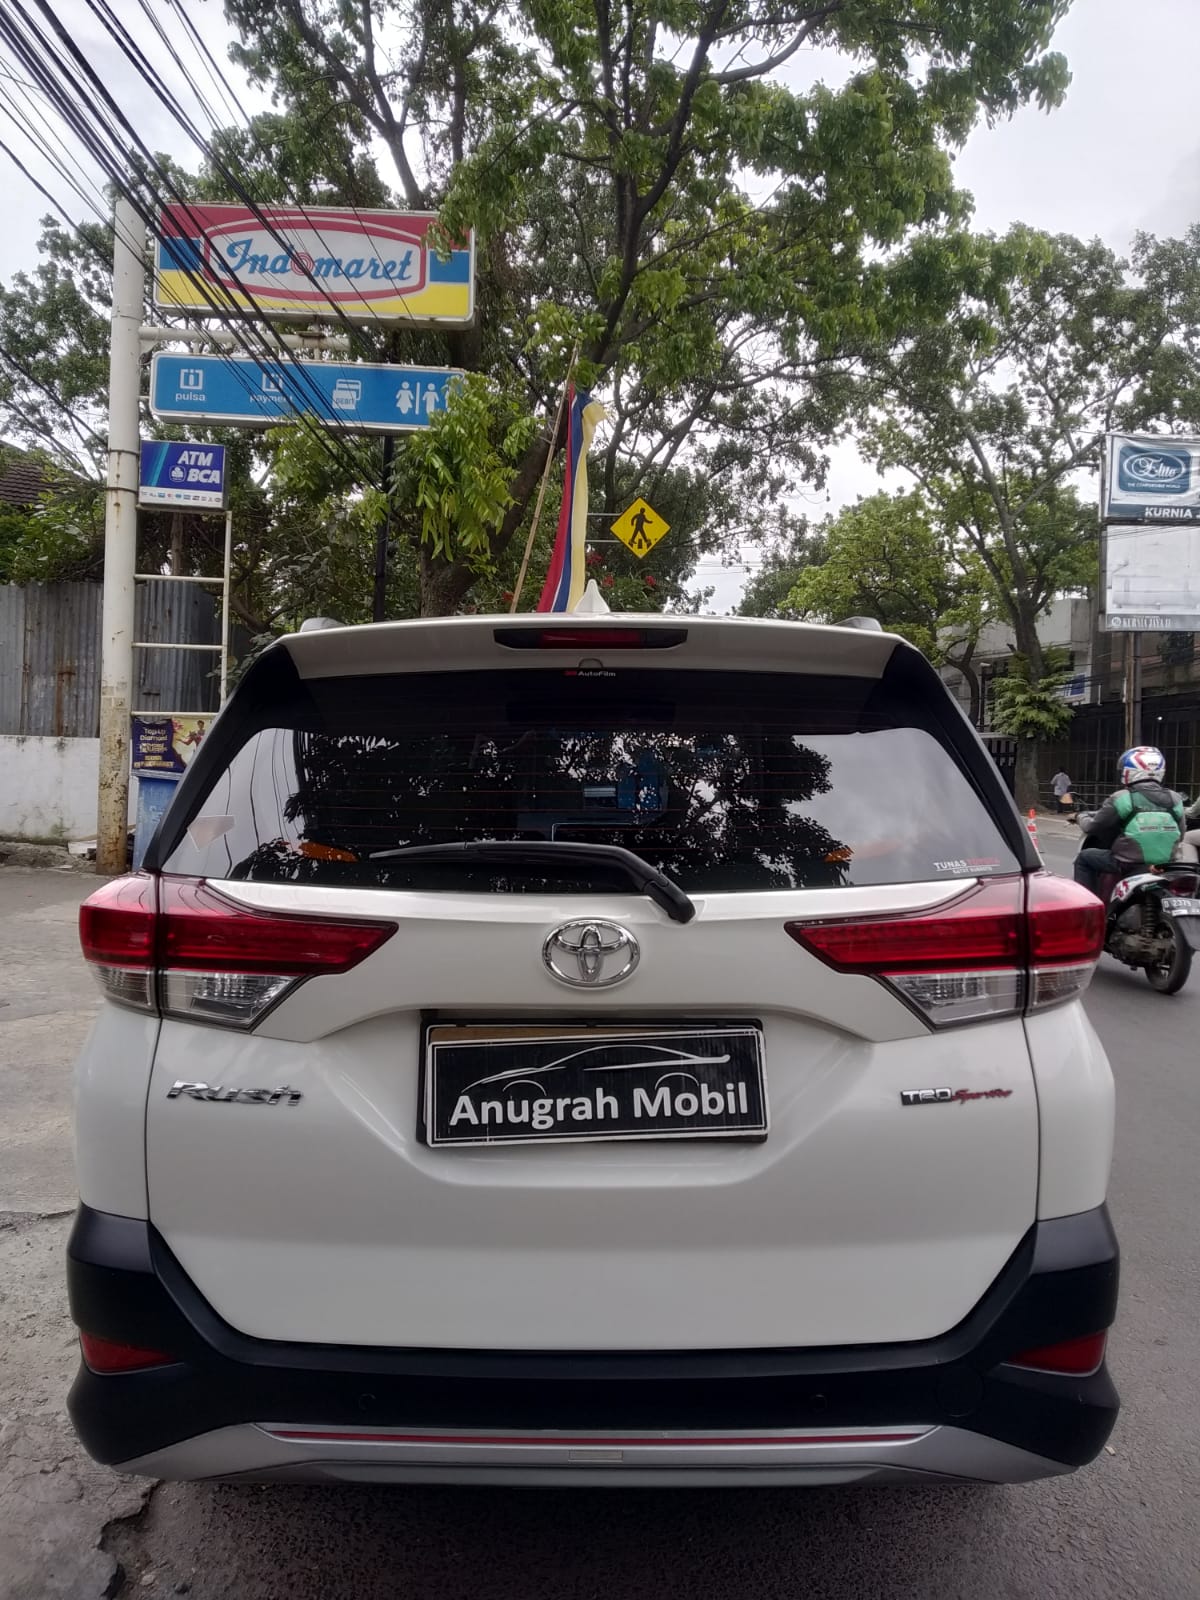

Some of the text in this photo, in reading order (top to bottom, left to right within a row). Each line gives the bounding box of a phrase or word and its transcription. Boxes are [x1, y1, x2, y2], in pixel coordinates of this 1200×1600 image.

[218, 238, 413, 281] Indomaret
[175, 391, 206, 402] pulsa
[177, 450, 213, 467] ATM
[187, 468, 221, 484] BCA
[1144, 506, 1193, 519] KURNIA
[577, 670, 617, 678] AutoFilm
[933, 860, 967, 870] TUNAS
[167, 1080, 303, 1106] Rush
[901, 1087, 952, 1105] TRD
[450, 1082, 748, 1130] Anugrah Mobil
